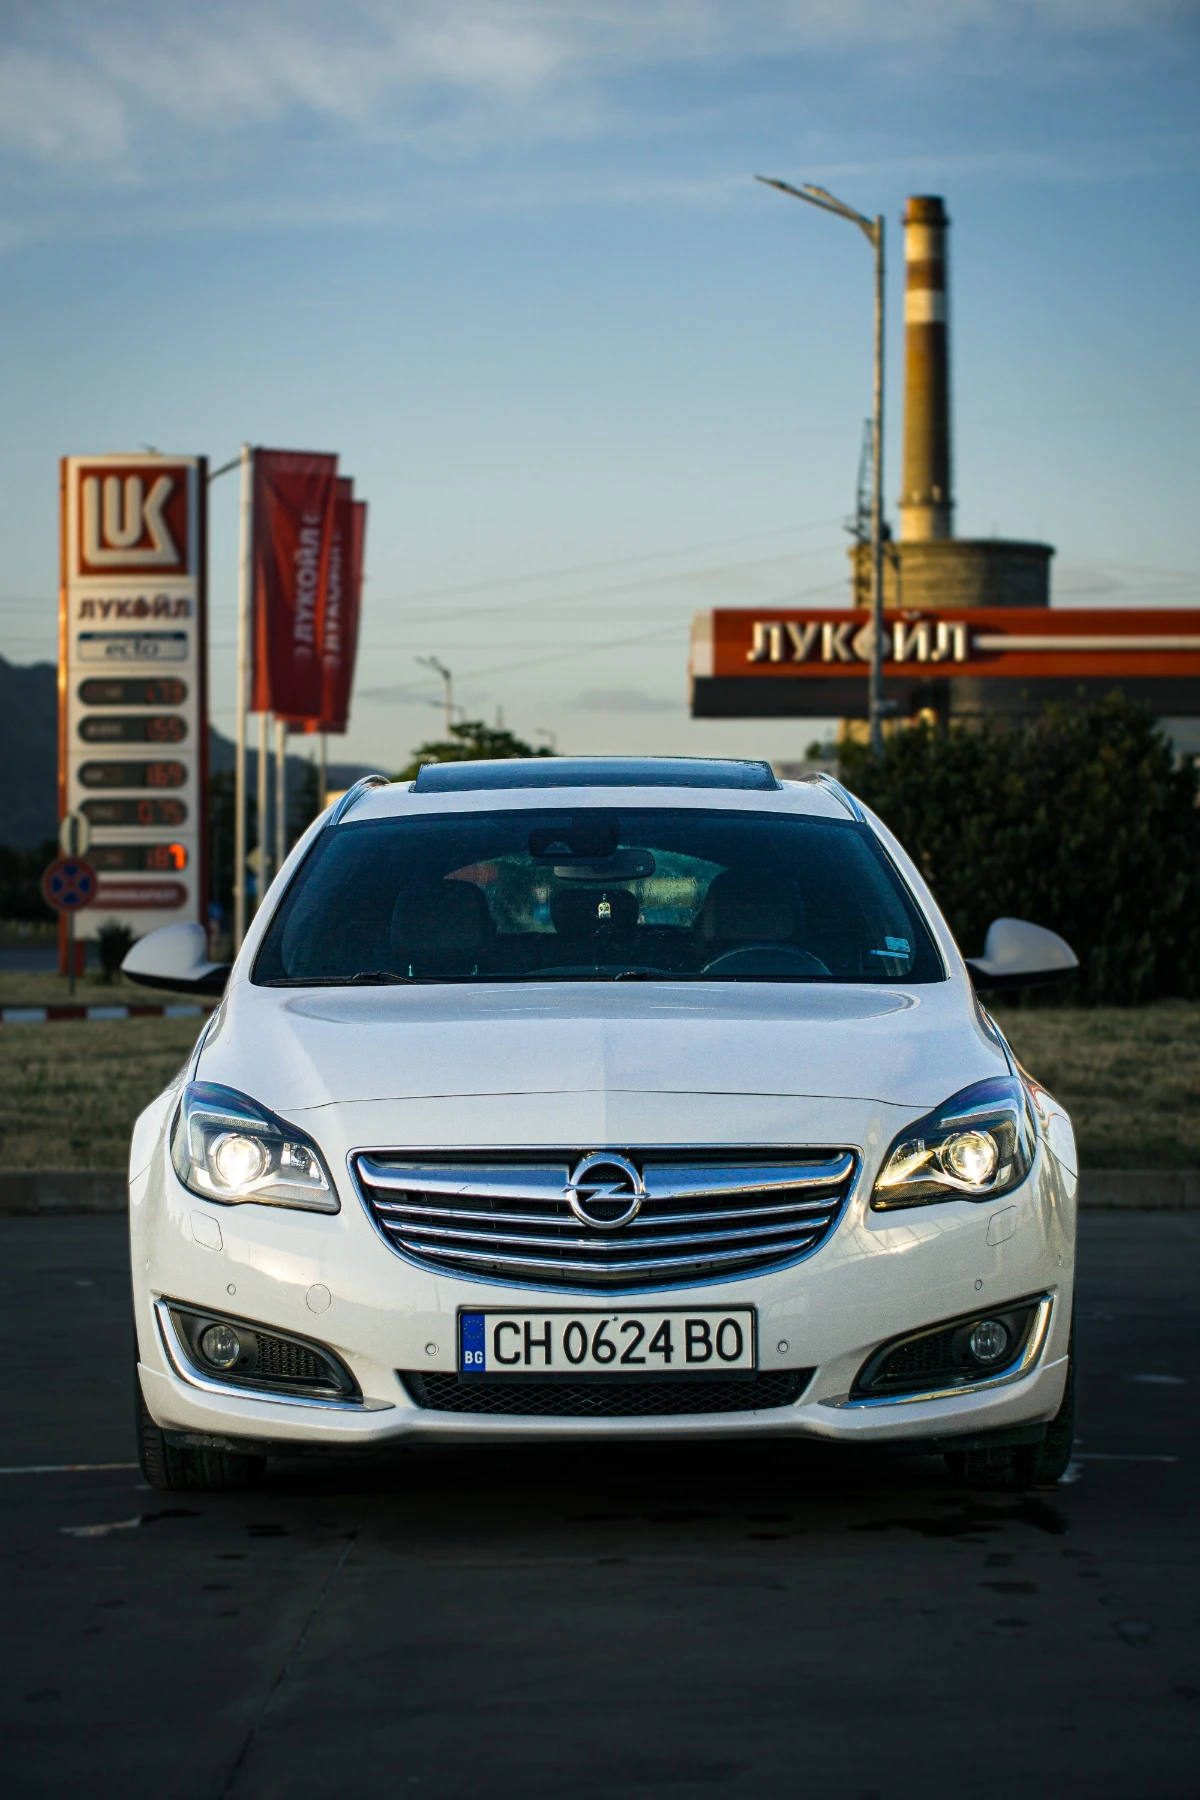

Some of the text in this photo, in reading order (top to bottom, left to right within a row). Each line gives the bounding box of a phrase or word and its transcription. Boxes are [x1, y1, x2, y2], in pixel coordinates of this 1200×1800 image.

[293, 527, 320, 644] ЛУКОЙЛ
[104, 639, 160, 658] ecto
[463, 1350, 483, 1364] BG
[493, 1320, 552, 1365] CH
[562, 1319, 674, 1365] 0624
